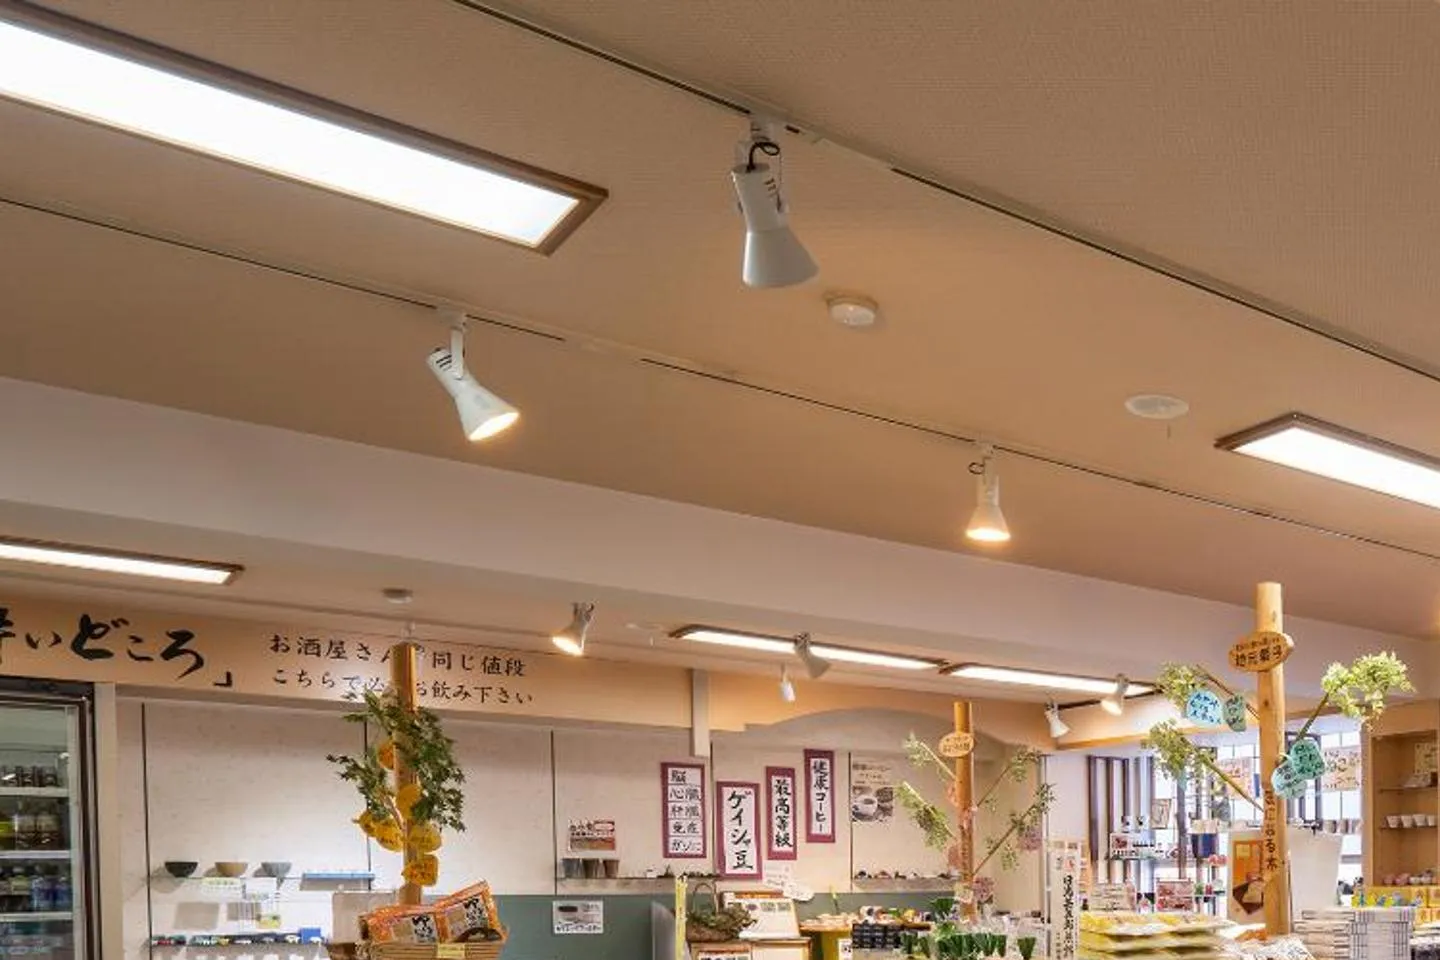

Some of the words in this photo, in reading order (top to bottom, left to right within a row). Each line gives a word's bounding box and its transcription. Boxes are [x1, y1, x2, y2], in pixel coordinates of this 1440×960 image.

[727, 789, 754, 871] ゲイシャ豆
[774, 779, 794, 849] 最高等級
